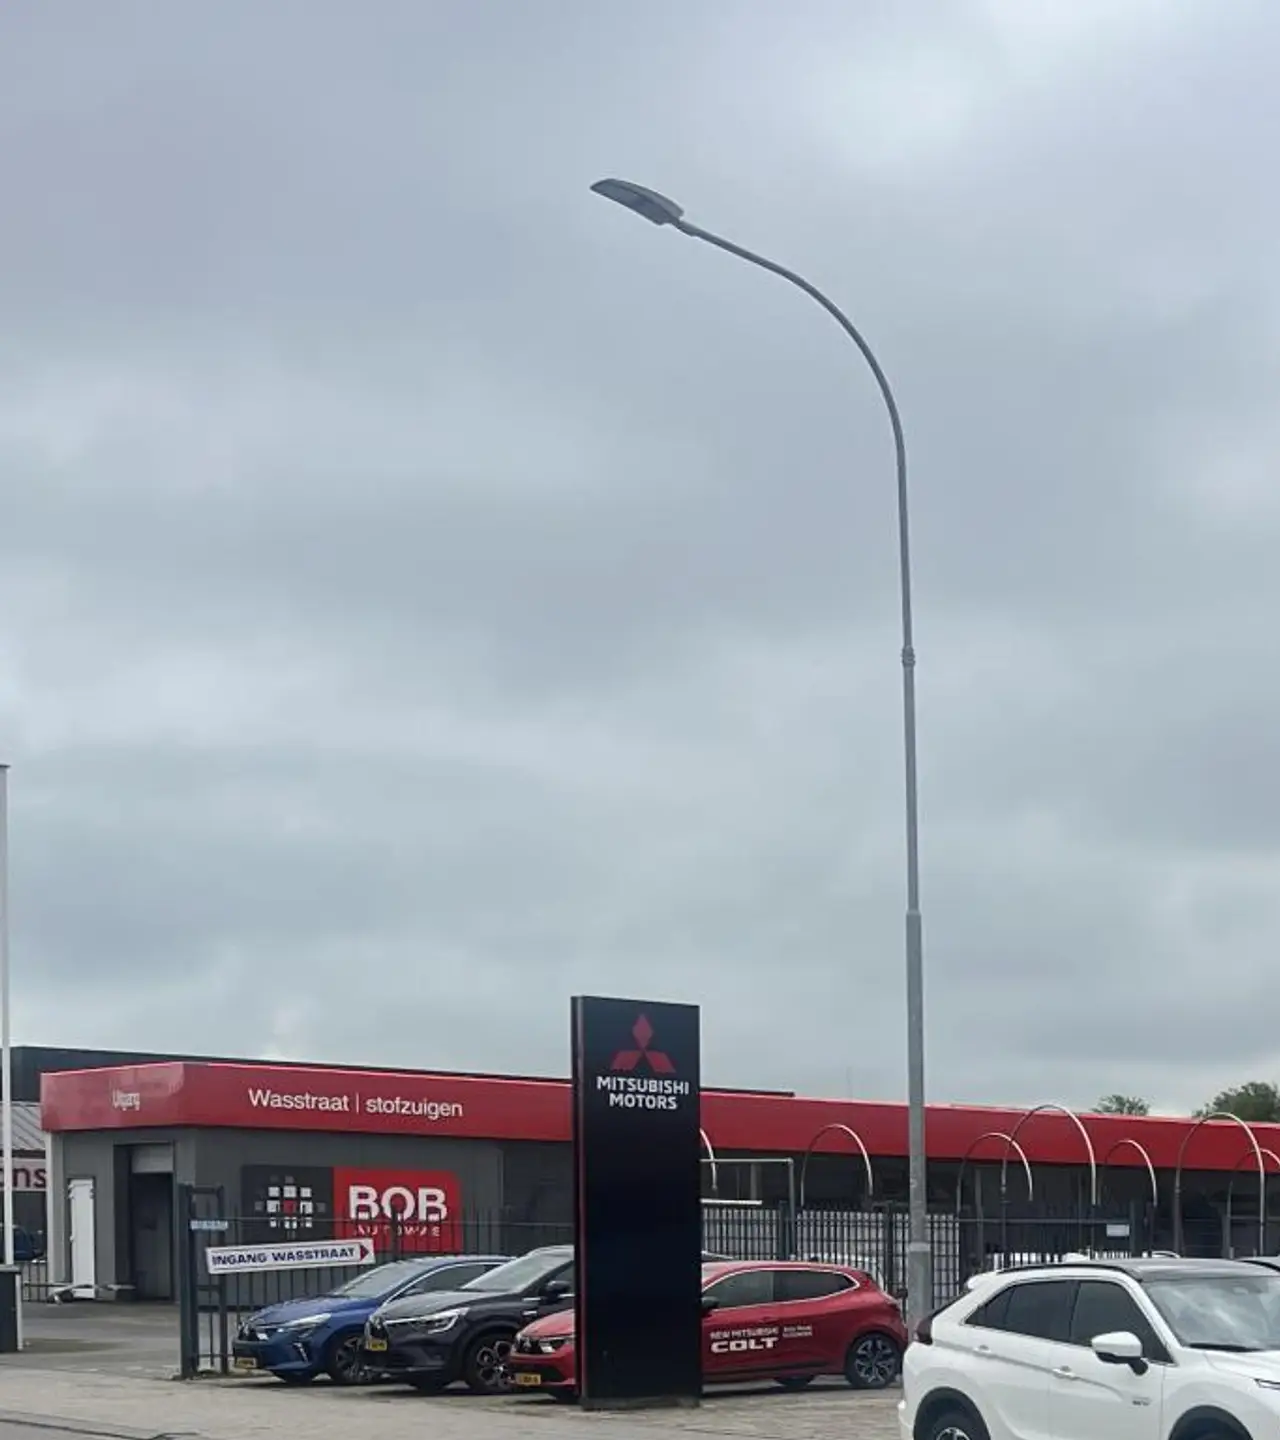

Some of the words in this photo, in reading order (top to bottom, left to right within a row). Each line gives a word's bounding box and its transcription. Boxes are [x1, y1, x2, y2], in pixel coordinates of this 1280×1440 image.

[596, 1075, 690, 1096] MITSUBISHI
[248, 1088, 350, 1113] Wasstraat
[366, 1095, 464, 1120] stofzuigen
[608, 1091, 678, 1111] MOTORS
[349, 1183, 448, 1222] BOB
[211, 1250, 268, 1267] INGANG
[271, 1245, 355, 1264] WASSTRAAT
[710, 1336, 780, 1354] COLT
